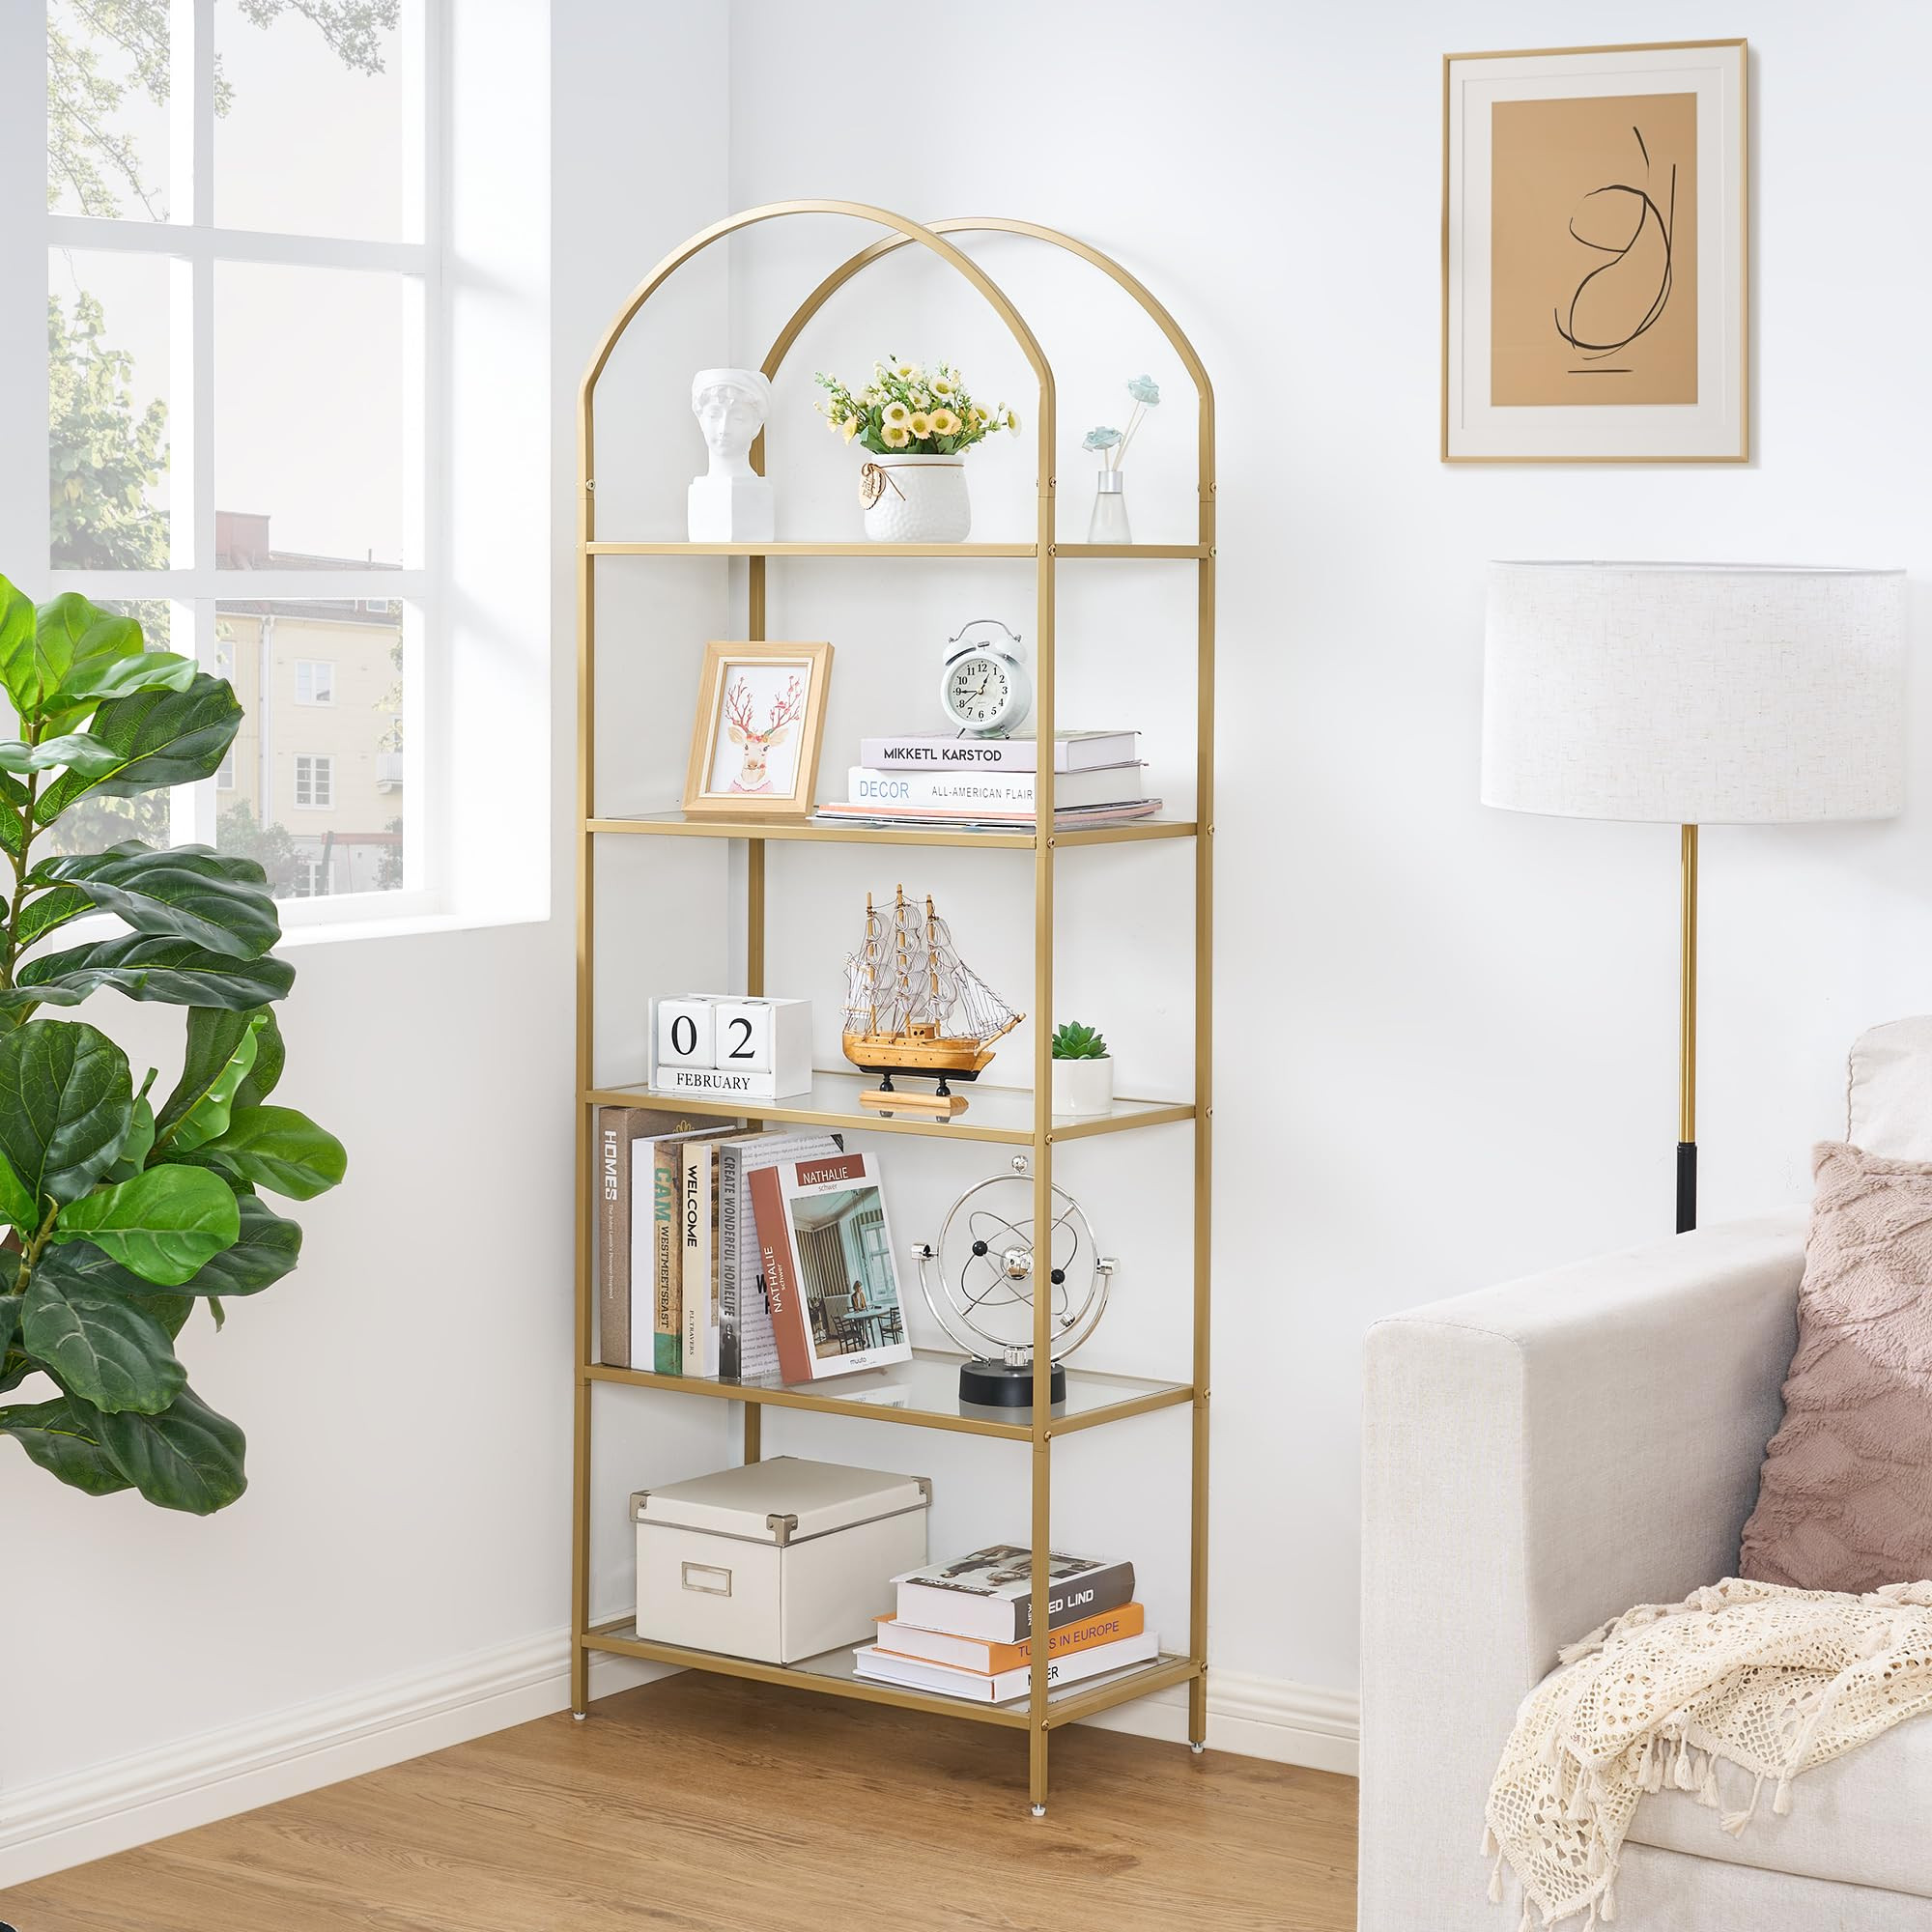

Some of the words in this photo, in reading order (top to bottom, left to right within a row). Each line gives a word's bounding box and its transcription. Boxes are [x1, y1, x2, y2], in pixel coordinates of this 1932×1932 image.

[978, 664, 987, 672] 12
[958, 676, 968, 685] 10
[999, 674, 1005, 684] 2
[955, 687, 962, 696] 9
[1002, 686, 1008, 695] 3
[958, 699, 965, 708] 8
[967, 707, 973, 716] 7
[978, 710, 984, 719] 6
[883, 748, 938, 761] MIKKETL
[942, 749, 1002, 762] KARSTOD
[859, 781, 910, 799] DECOR
[931, 785, 1002, 800] ALL-AMERICAN
[1006, 787, 1034, 801] FLAIR
[676, 1072, 751, 1091] FEBRUARY
[604, 1130, 618, 1201] HOMES
[724, 1156, 736, 1193] CREATE
[803, 1167, 849, 1184] NATHALIE
[654, 1167, 672, 1222] CAM
[687, 1165, 697, 1248] WELCOME
[724, 1198, 736, 1262] WONDERFUL
[763, 1246, 782, 1313] NATHALIE
[724, 1264, 736, 1317] HOMELIFE
[1067, 1589, 1094, 1607] LIND
[1060, 1634, 1070, 1646] IN
[1074, 1621, 1120, 1643] EUROPE
